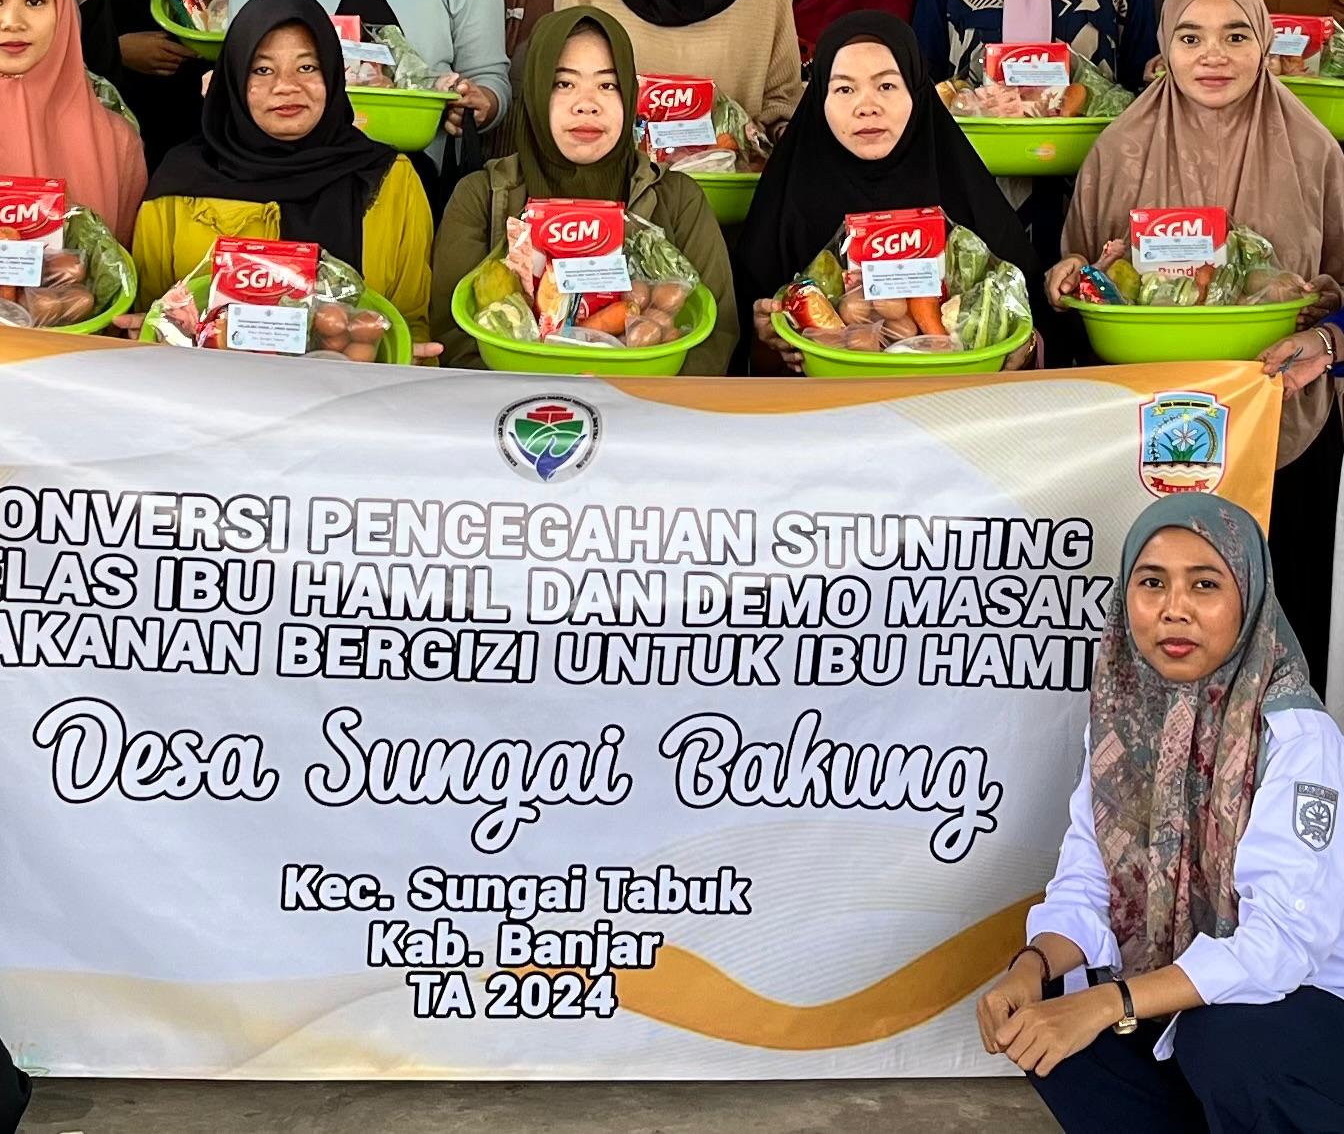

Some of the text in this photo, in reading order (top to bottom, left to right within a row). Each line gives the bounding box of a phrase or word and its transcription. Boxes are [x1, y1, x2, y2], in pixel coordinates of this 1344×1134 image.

[649, 87, 693, 109] SGM
[548, 219, 601, 243] SGM
[871, 229, 921, 258] SGM
[308, 496, 755, 567] PENCEGAHAN
[771, 509, 1094, 572] STUNTING
[155, 558, 275, 615] IBU
[290, 563, 509, 623] HAMIL
[527, 569, 667, 628] DAN
[680, 572, 872, 630] DEMO
[885, 574, 1116, 632] MASAK
[277, 625, 537, 684] BERGIZI
[555, 631, 779, 688] UNTUK
[793, 633, 905, 690] IBU
[33, 697, 1003, 863] Desa Sungai Bakung
[281, 864, 752, 924] Kec. Sungai Tabuk
[367, 918, 662, 978] Kab. Banjar
[407, 971, 618, 1020] TA 2024
